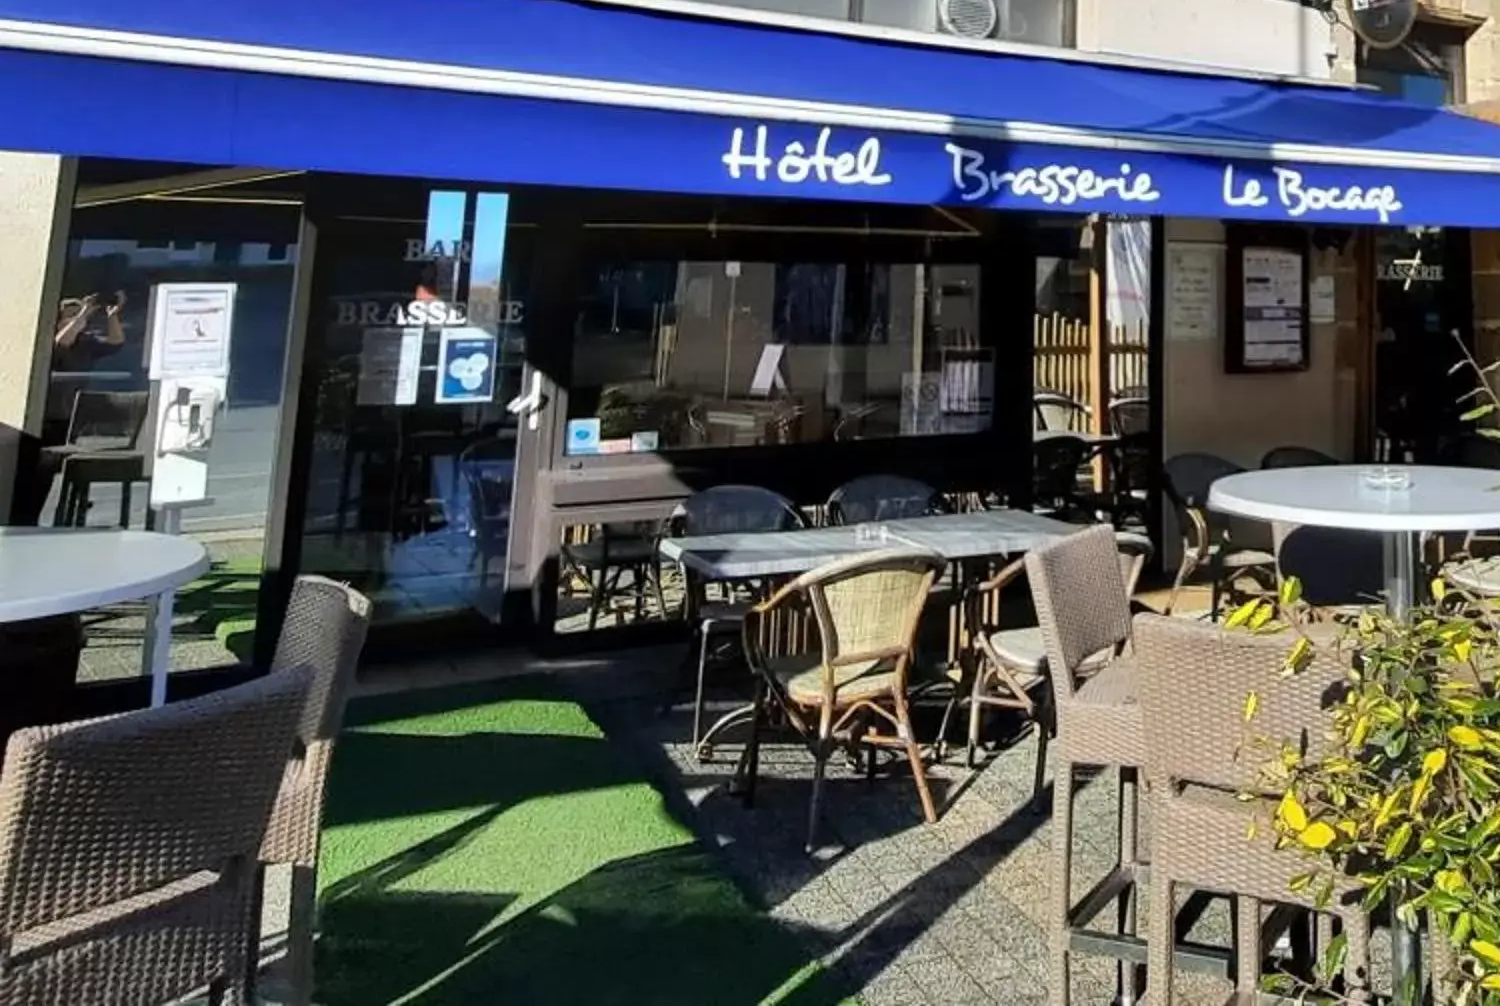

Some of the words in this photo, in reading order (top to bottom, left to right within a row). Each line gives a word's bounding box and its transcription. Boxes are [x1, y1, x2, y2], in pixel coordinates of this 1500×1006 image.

[722, 125, 892, 185] Hôtel
[944, 143, 1160, 204] Brasserie
[1223, 163, 1269, 206] Le
[1272, 166, 1403, 223] Bocage
[402, 238, 471, 262] BAR
